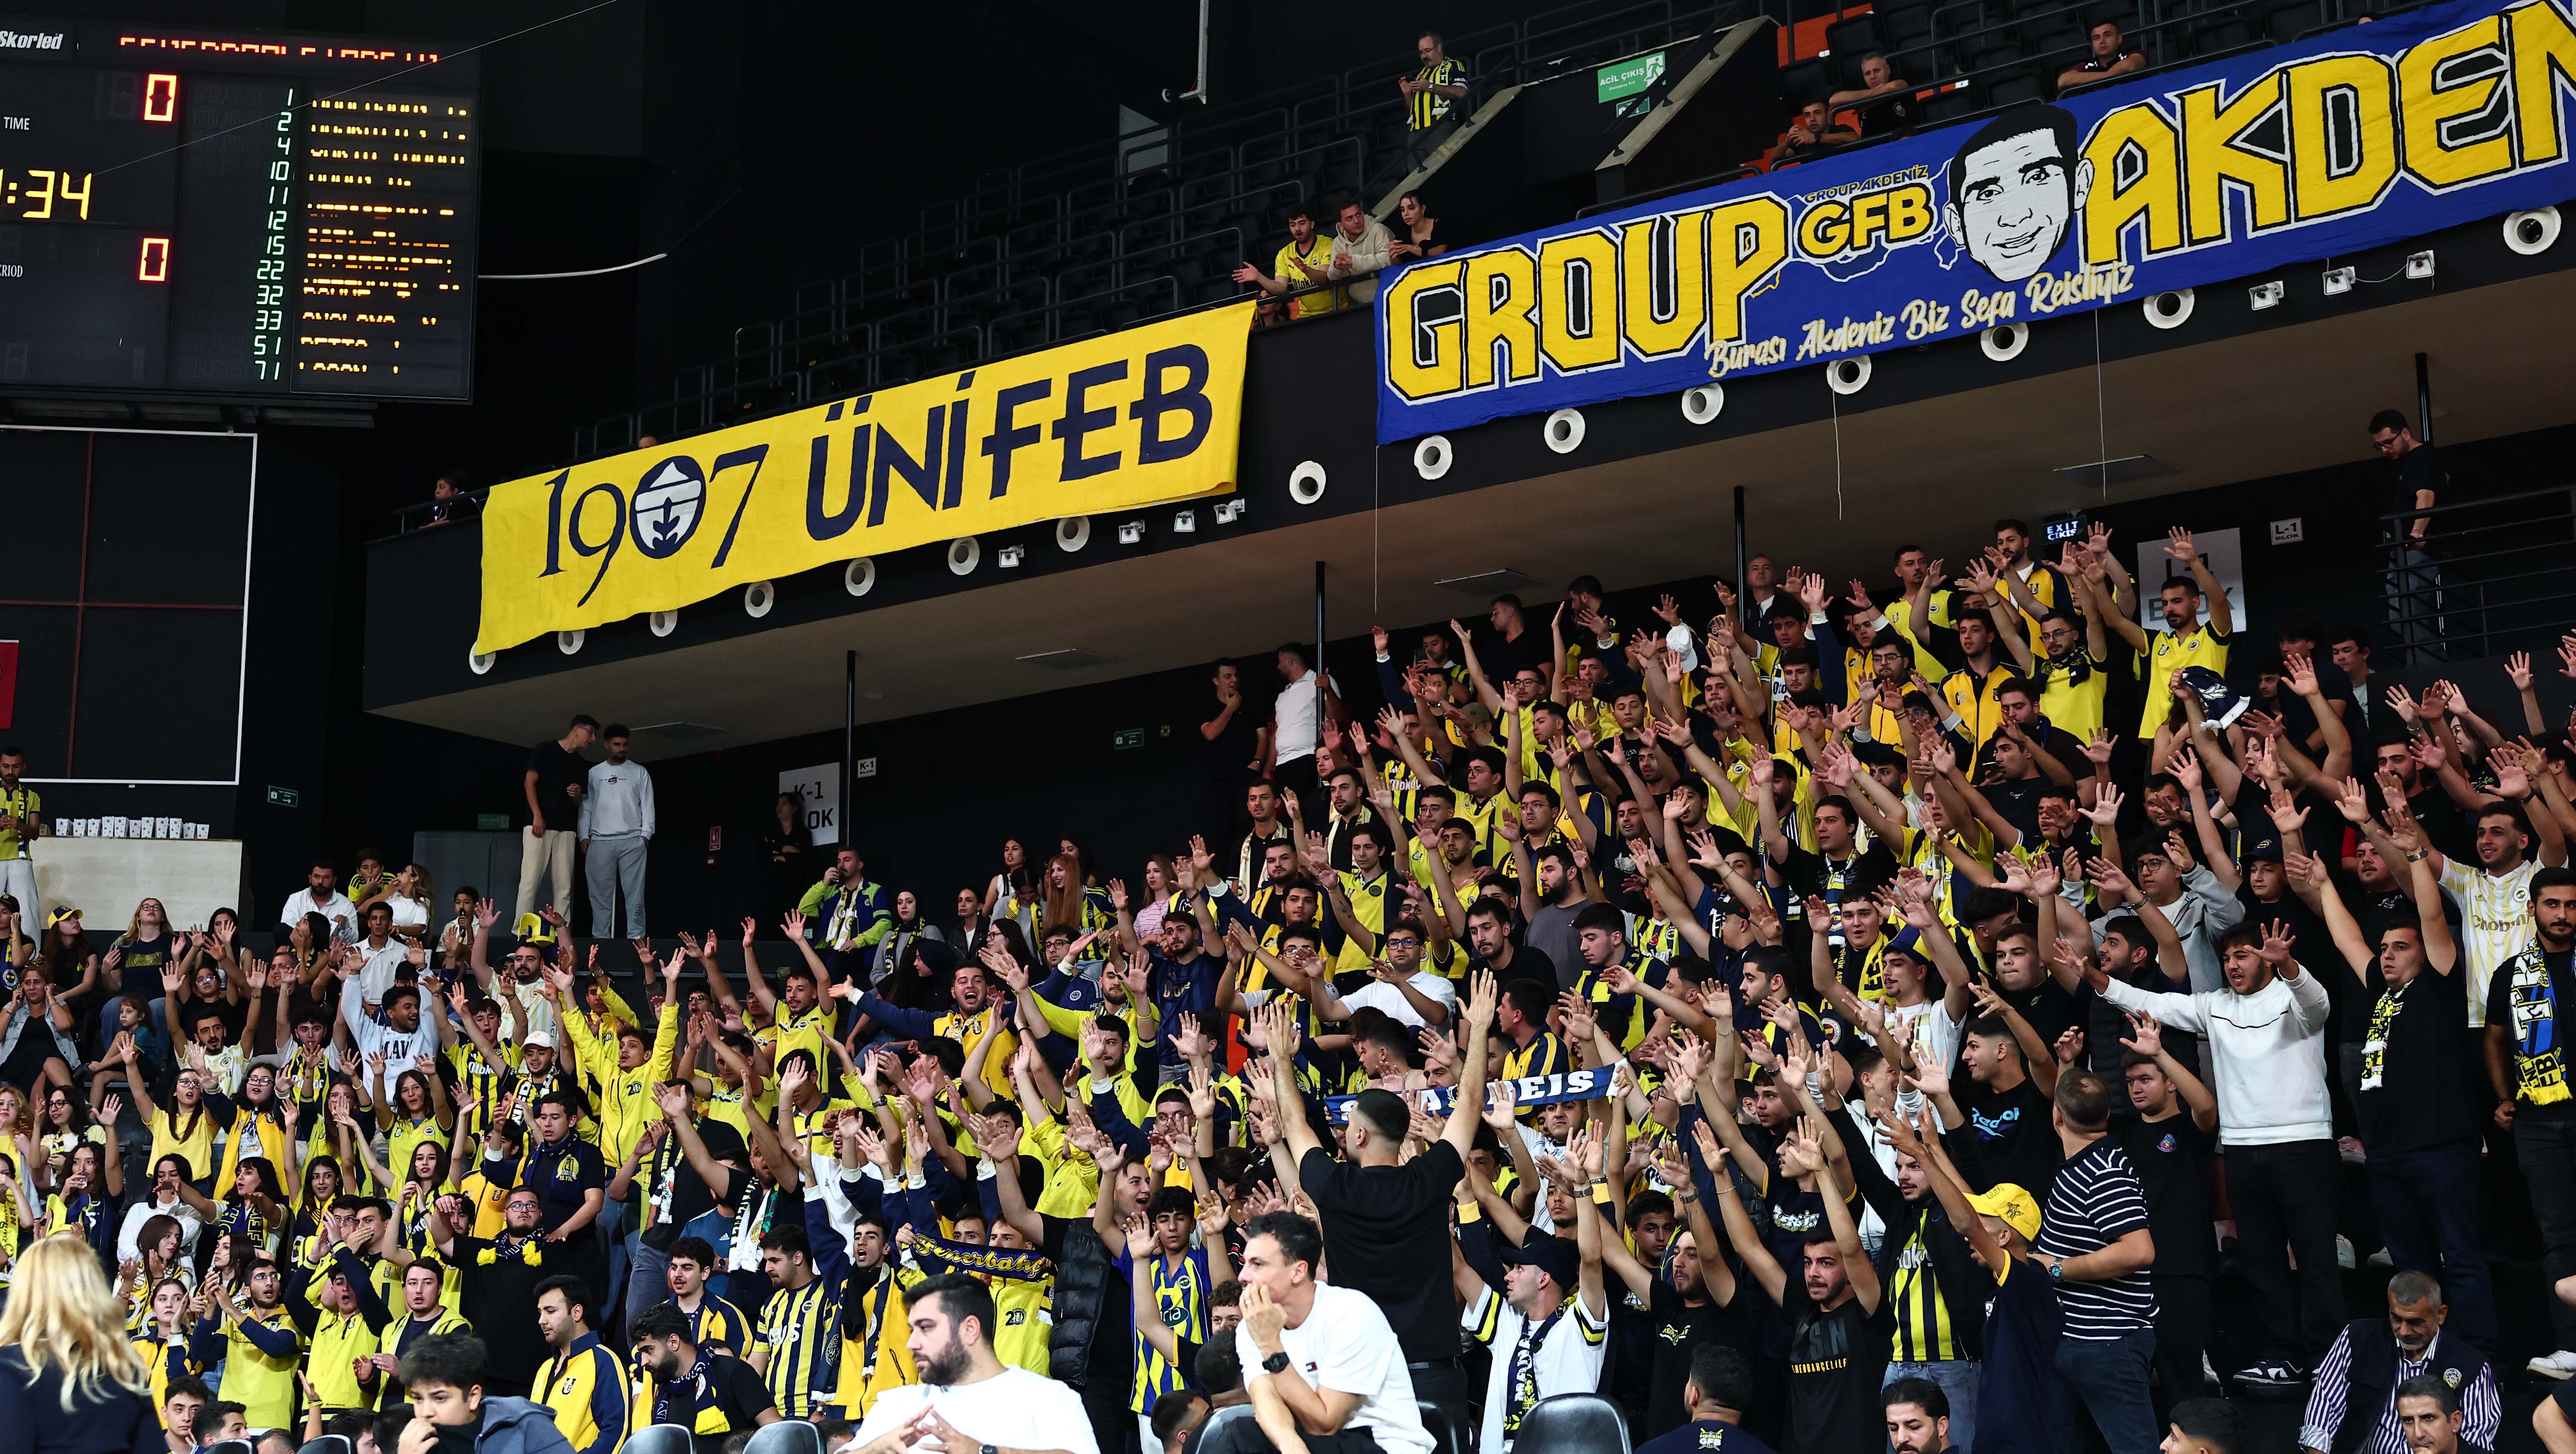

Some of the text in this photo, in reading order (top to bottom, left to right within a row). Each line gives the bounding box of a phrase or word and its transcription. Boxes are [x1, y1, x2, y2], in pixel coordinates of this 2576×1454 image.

[0, 31, 63, 50] Skorled
[144, 74, 177, 121] 0
[287, 88, 293, 106] 1
[4, 117, 30, 130] TIME
[278, 112, 292, 131] 2
[278, 137, 290, 155] 4
[270, 161, 289, 180] 10
[269, 186, 288, 204] 11
[1804, 182, 1860, 203] GROUP
[268, 210, 287, 230] 12
[1795, 182, 1937, 260] GFB
[267, 235, 285, 255] 15
[139, 238, 169, 281] 0
[257, 260, 284, 280] 22
[256, 285, 283, 305] 32
[1384, 191, 1792, 406] GROUP
[255, 310, 282, 330] 33
[1796, 311, 1897, 361] Akdeniz
[1900, 298, 1950, 341] Biz
[1960, 287, 2017, 329] Sefa
[254, 335, 281, 355] 51
[255, 360, 280, 380] 71
[537, 343, 1213, 607] 1907 ÜNİFEB
[2047, 521, 2078, 534] EXIT
[2275, 522, 2297, 535] L-1
[860, 761, 874, 770] K-1
[807, 808, 834, 830] OK
[914, 1233, 1043, 1278] Fenerbahç
